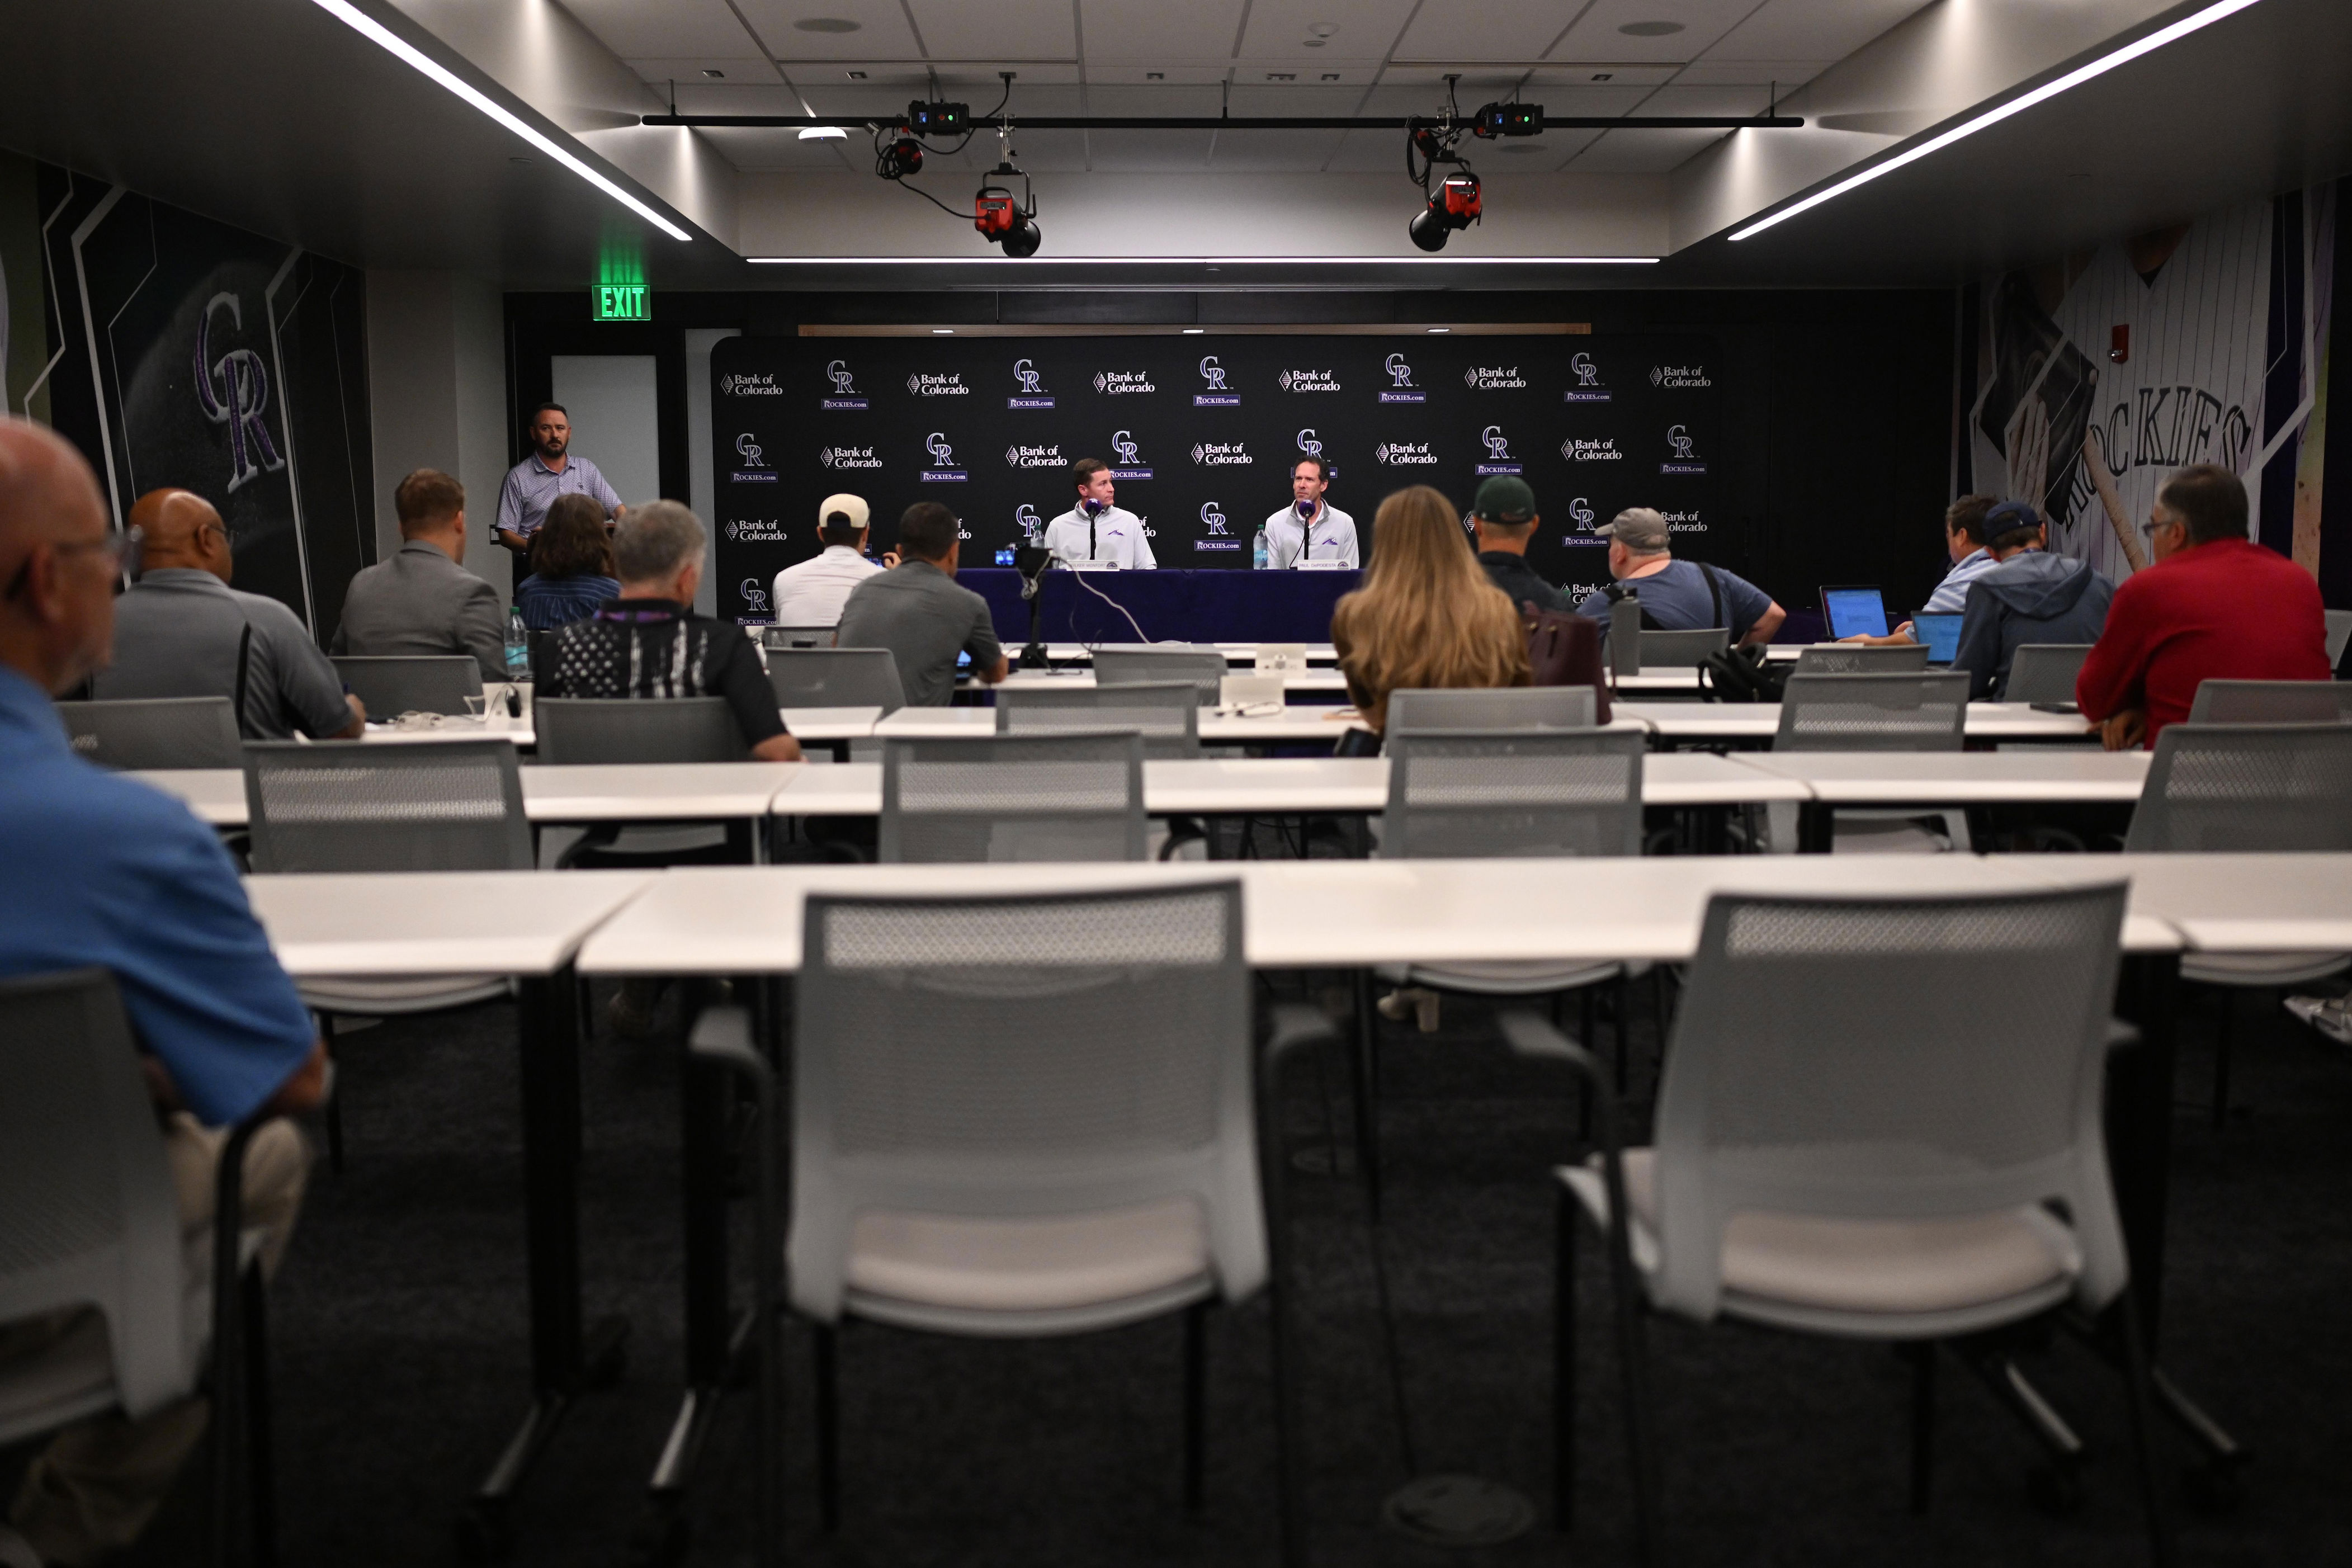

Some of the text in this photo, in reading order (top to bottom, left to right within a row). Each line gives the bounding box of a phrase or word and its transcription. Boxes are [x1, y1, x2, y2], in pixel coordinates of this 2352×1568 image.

[601, 287, 644, 317] EXIT
[1293, 369, 1332, 380] Bank of
[1479, 367, 1518, 377] Bank of
[1664, 366, 1702, 376] Bank of
[735, 374, 774, 384] Bank of
[921, 374, 960, 384] Bank of
[1107, 371, 1146, 382] Bank of
[1664, 376, 1712, 387] Colorado
[1107, 381, 1155, 393] Colorado
[1293, 380, 1341, 390] Colorado
[1479, 377, 1527, 388] Colorado
[735, 384, 783, 395] Colorado
[921, 384, 969, 395] Colorado
[1196, 396, 1239, 405] ROCKIES.com
[1381, 393, 1424, 402] ROCKIES.com
[1566, 393, 1609, 401] ROCKIES.com
[824, 400, 867, 409] ROCKIES.com
[1010, 399, 1053, 408] ROCKIES.com
[1205, 443, 1244, 454] Bank of
[1390, 442, 1428, 453] Bank of
[1575, 438, 1614, 449] Bank of
[834, 446, 873, 457] Bank of
[1019, 445, 1058, 456] Bank of
[1575, 448, 1623, 460] Colorado
[834, 456, 882, 467] Colorado
[1019, 455, 1068, 466] Colorado
[1205, 453, 1253, 464] Colorado
[1390, 453, 1438, 463] Colorado
[1477, 465, 1520, 474] ROCKIES.com
[1662, 464, 1705, 473] ROCKIES.com
[733, 473, 776, 481] ROCKIES.com
[923, 472, 966, 481] ROCKIES.com
[1661, 511, 1699, 521] Bank of
[739, 519, 778, 530] Bank of
[1664, 521, 1708, 531] olorado
[739, 530, 787, 540] Colorado
[1196, 541, 1239, 550] ROCKIES.com
[1564, 537, 1607, 546] ROCKIES.com
[1572, 583, 1598, 593] Bank
